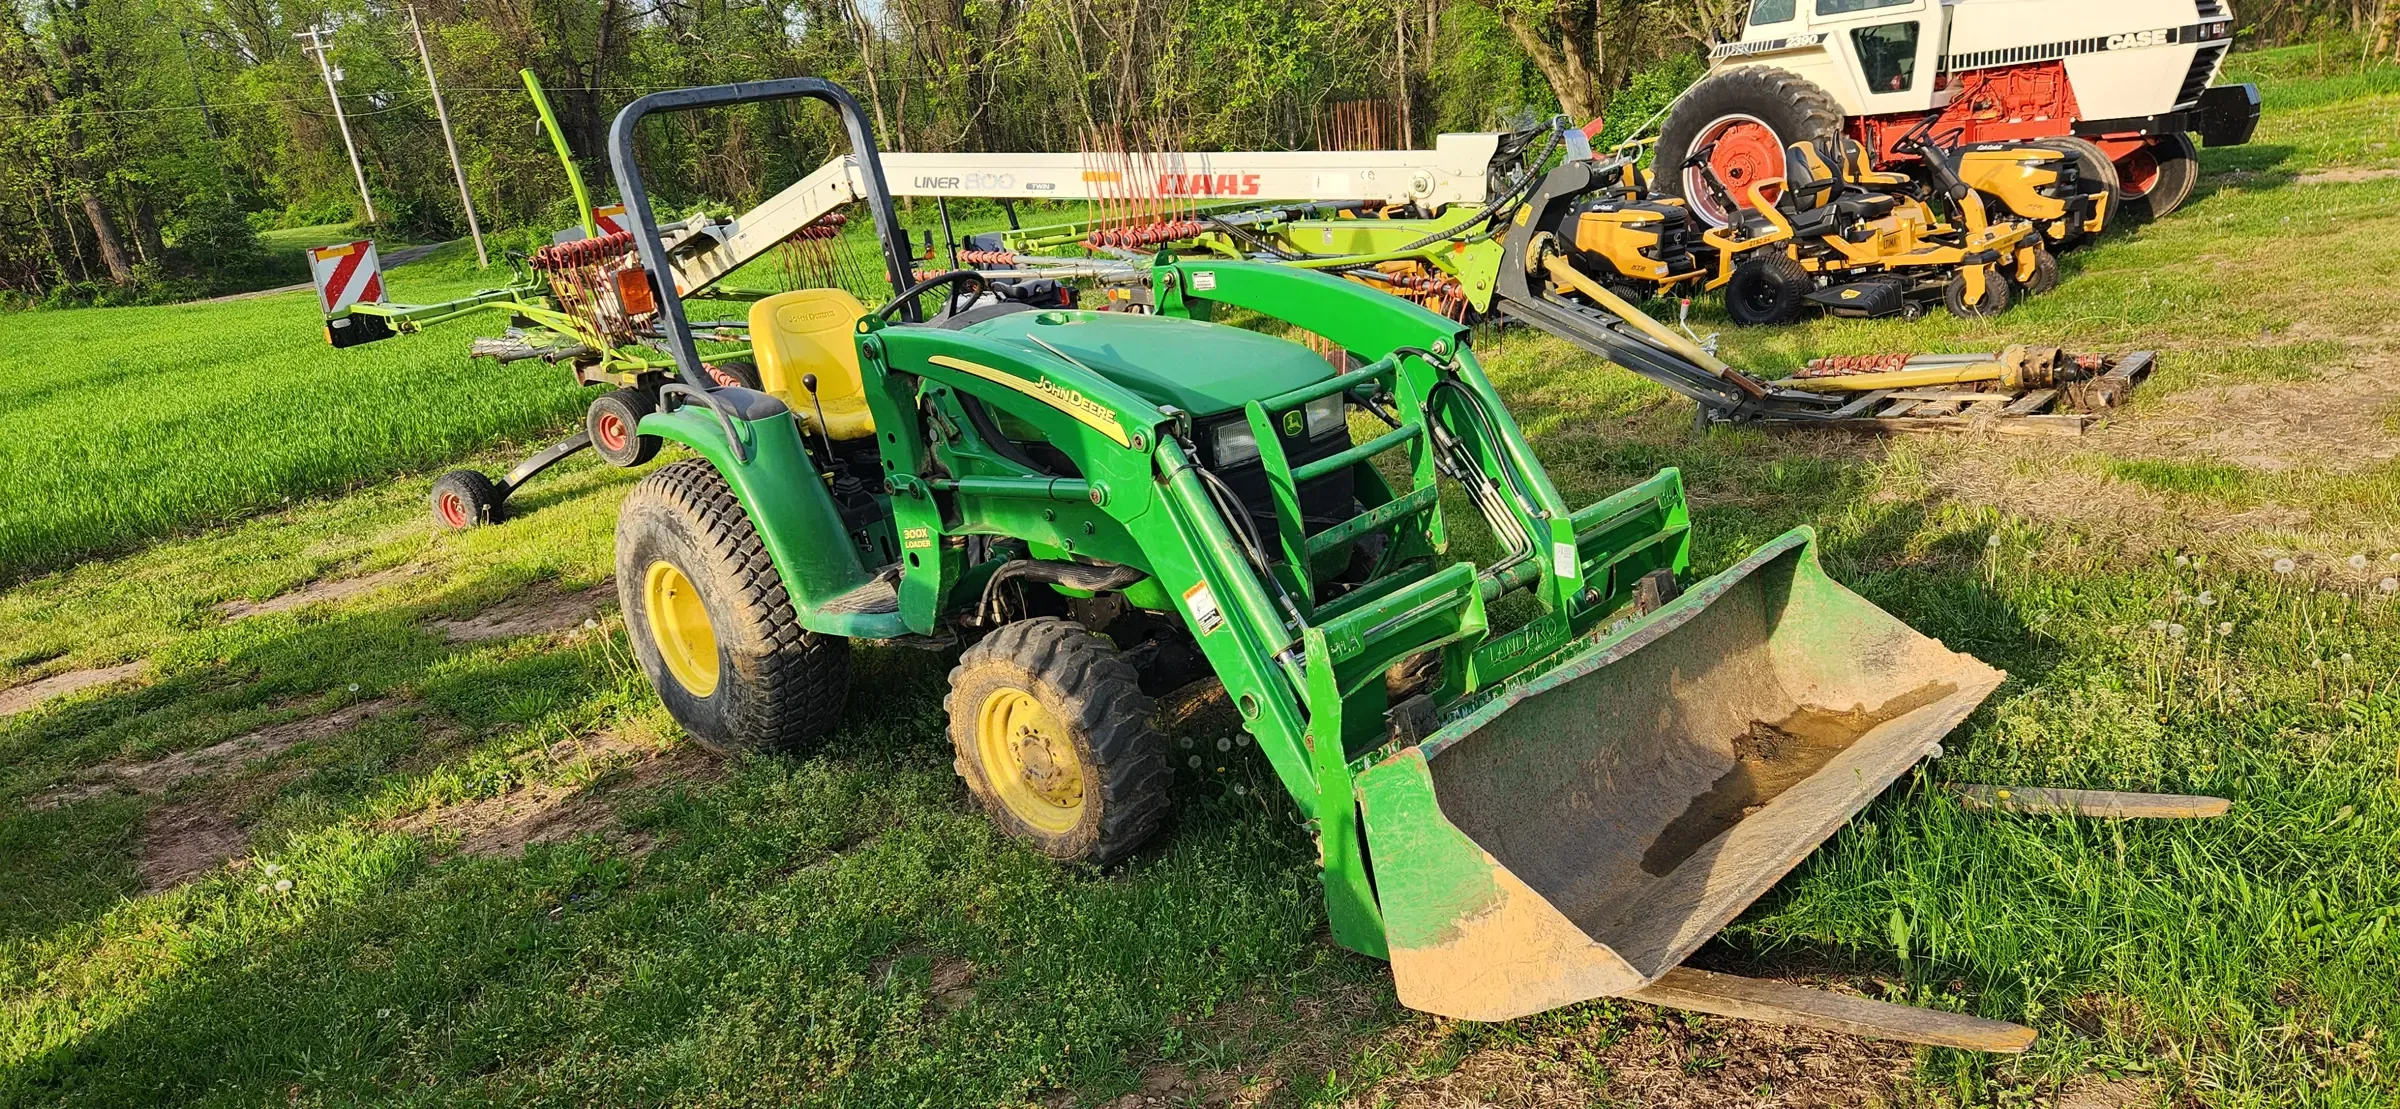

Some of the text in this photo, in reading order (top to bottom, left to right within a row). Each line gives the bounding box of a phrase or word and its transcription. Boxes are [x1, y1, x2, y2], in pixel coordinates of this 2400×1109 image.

[1785, 34, 1819, 47] 2390
[2106, 28, 2168, 51] CASE
[914, 172, 1051, 191] LINER 800 TWIN
[1159, 174, 1260, 195] CLAAS
[1034, 375, 1117, 424] JOHN DEERE
[903, 527, 929, 540] 300X
[905, 539, 931, 549] LOADER
[1489, 617, 1558, 662] LANDPRO
